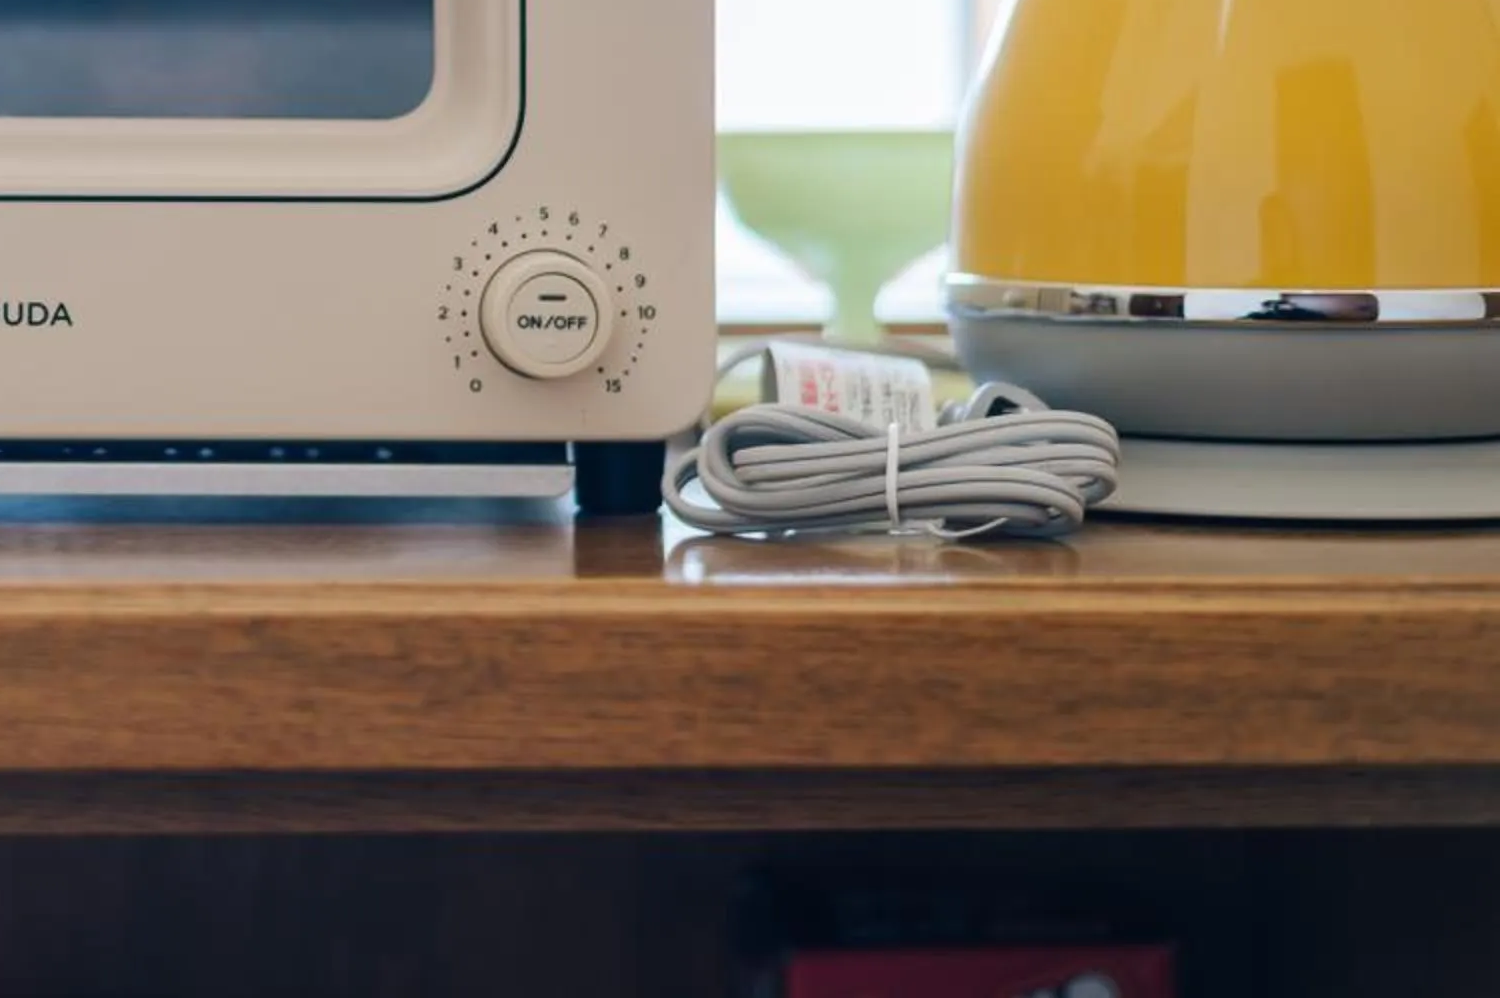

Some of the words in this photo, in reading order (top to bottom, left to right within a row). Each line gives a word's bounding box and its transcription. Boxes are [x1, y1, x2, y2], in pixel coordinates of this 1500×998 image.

[538, 206, 550, 221] 5
[568, 211, 580, 226] 6
[487, 222, 499, 236] 4
[598, 223, 609, 238] 7
[618, 246, 630, 261] 8
[452, 256, 464, 271] 3
[634, 273, 647, 288] 9
[437, 306, 450, 321] 2
[637, 305, 657, 321] 10
[517, 315, 588, 330] ON/OFF
[453, 354, 462, 370] 1
[469, 378, 483, 394] 0
[604, 378, 623, 395] 15
